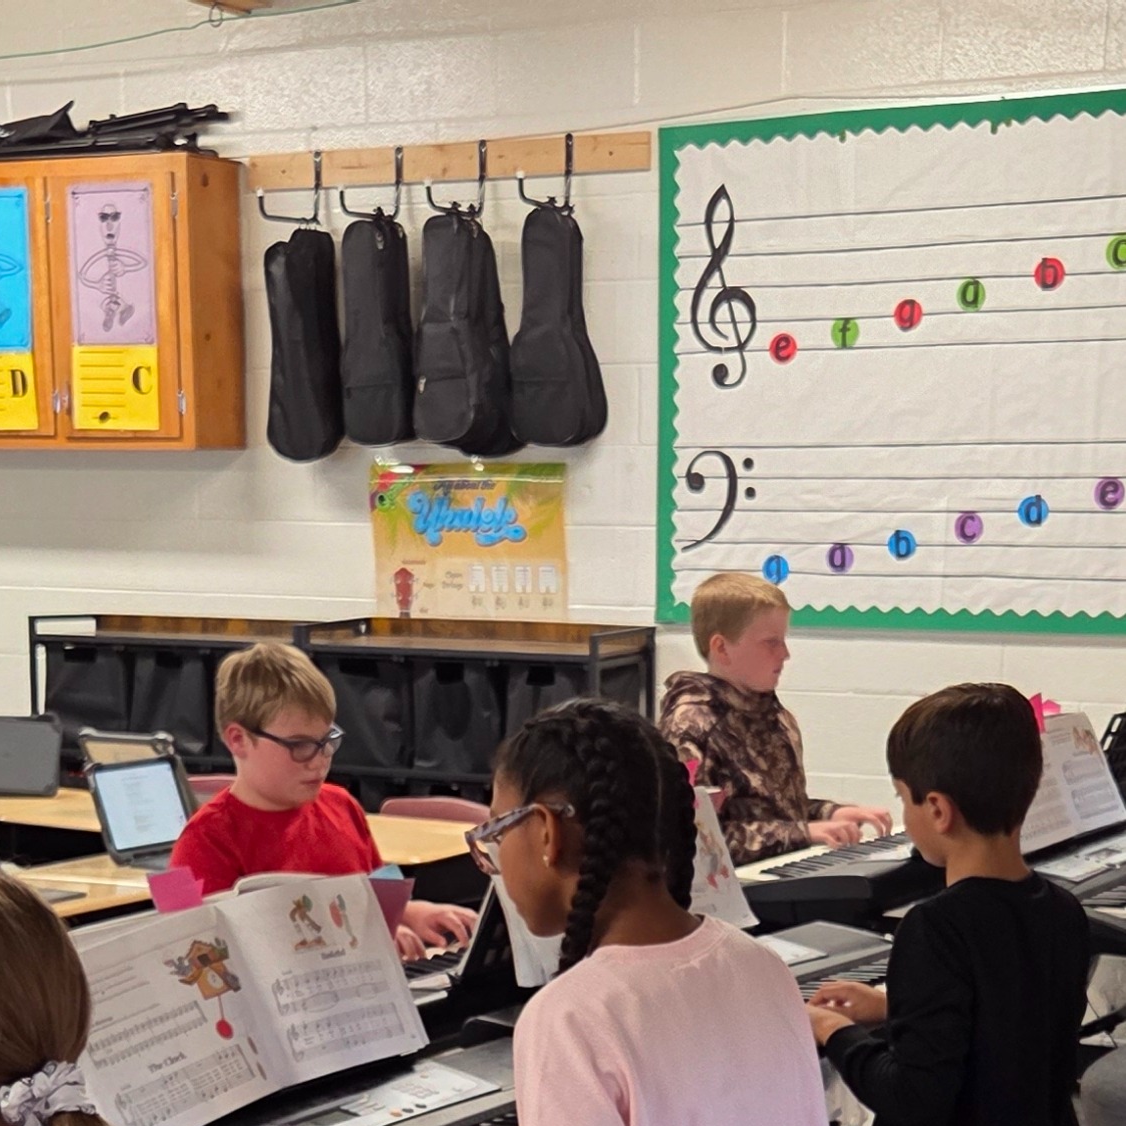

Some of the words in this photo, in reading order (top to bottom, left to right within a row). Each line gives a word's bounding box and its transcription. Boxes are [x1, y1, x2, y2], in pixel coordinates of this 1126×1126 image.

[775, 336, 792, 362] e
[838, 318, 851, 348] f
[901, 299, 916, 332] g
[1040, 258, 1058, 291] b
[9, 369, 28, 398] D
[132, 366, 153, 395] C
[895, 530, 911, 557] b
[961, 515, 977, 539] c
[1024, 494, 1043, 527] d
[1099, 481, 1119, 508] e
